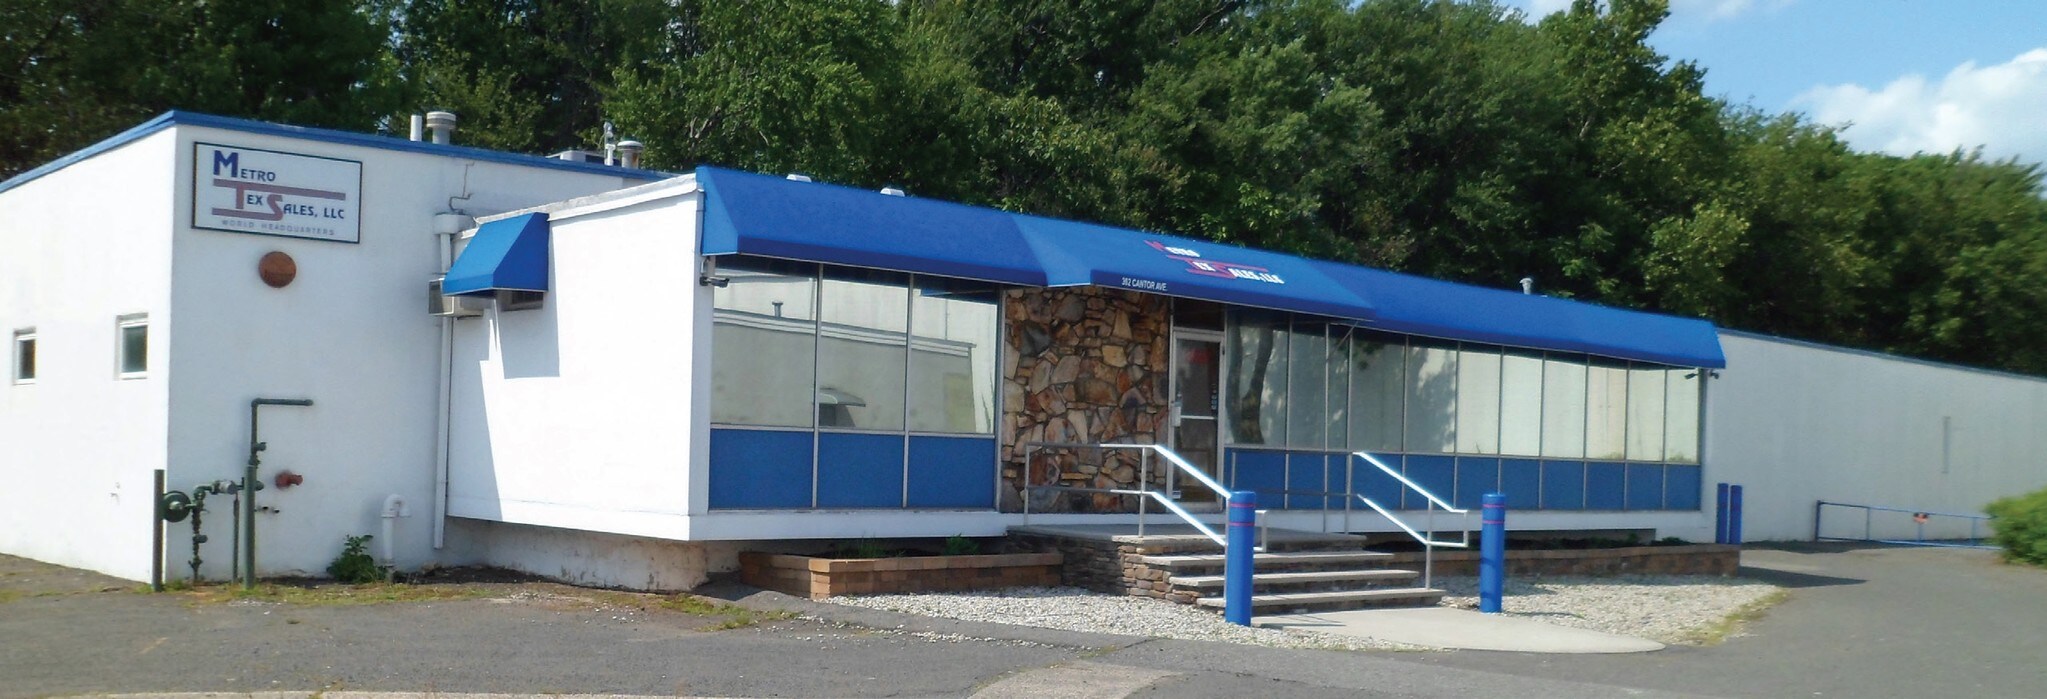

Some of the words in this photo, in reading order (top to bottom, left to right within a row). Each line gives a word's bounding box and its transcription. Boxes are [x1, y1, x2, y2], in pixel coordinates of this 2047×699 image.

[213, 150, 275, 182] METRO
[234, 181, 263, 210] TEX
[266, 193, 318, 221] SALES,
[323, 207, 345, 219] LLC
[222, 219, 255, 229] WORLD
[261, 222, 335, 236] HEADQUARTERS
[1132, 279, 1155, 289] CANTOR
